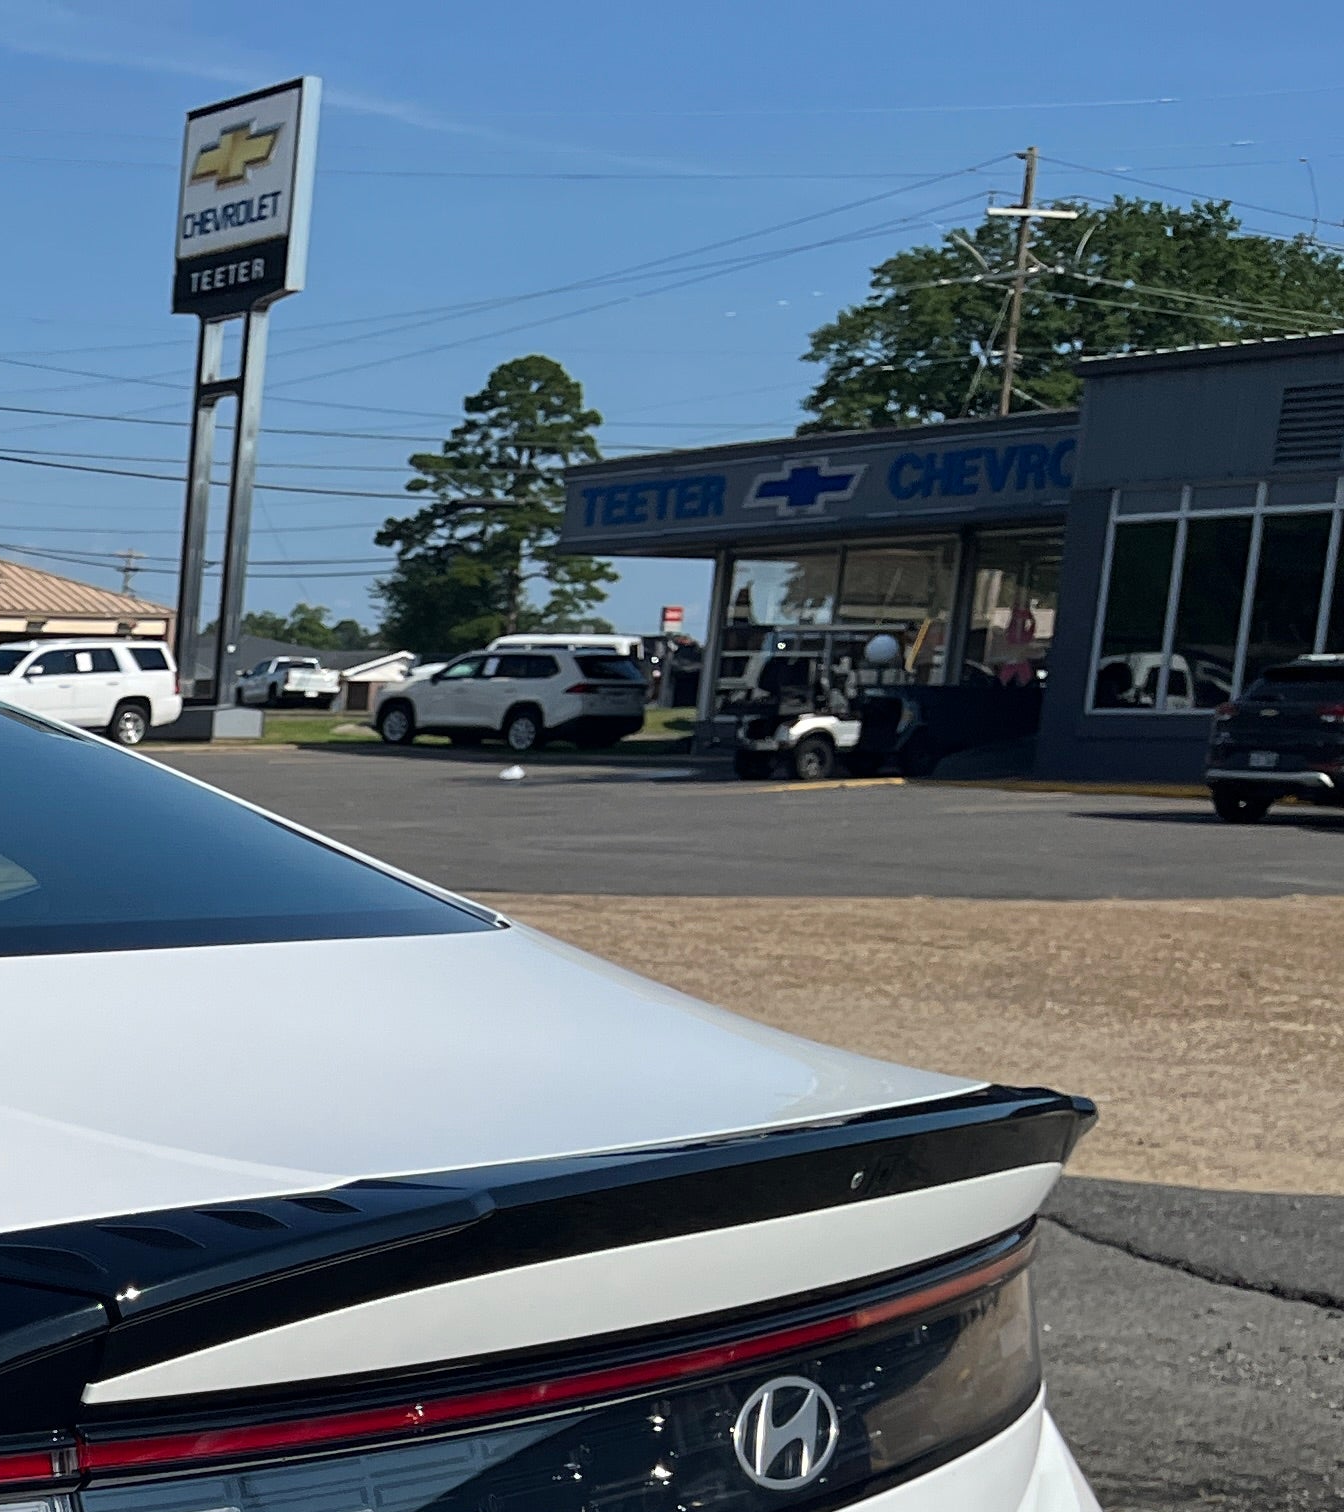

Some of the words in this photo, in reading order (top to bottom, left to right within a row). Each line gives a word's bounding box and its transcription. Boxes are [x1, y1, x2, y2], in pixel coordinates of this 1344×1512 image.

[183, 190, 282, 239] CHEVROLET
[191, 257, 266, 293] TEETER
[581, 474, 726, 528] TEETER
